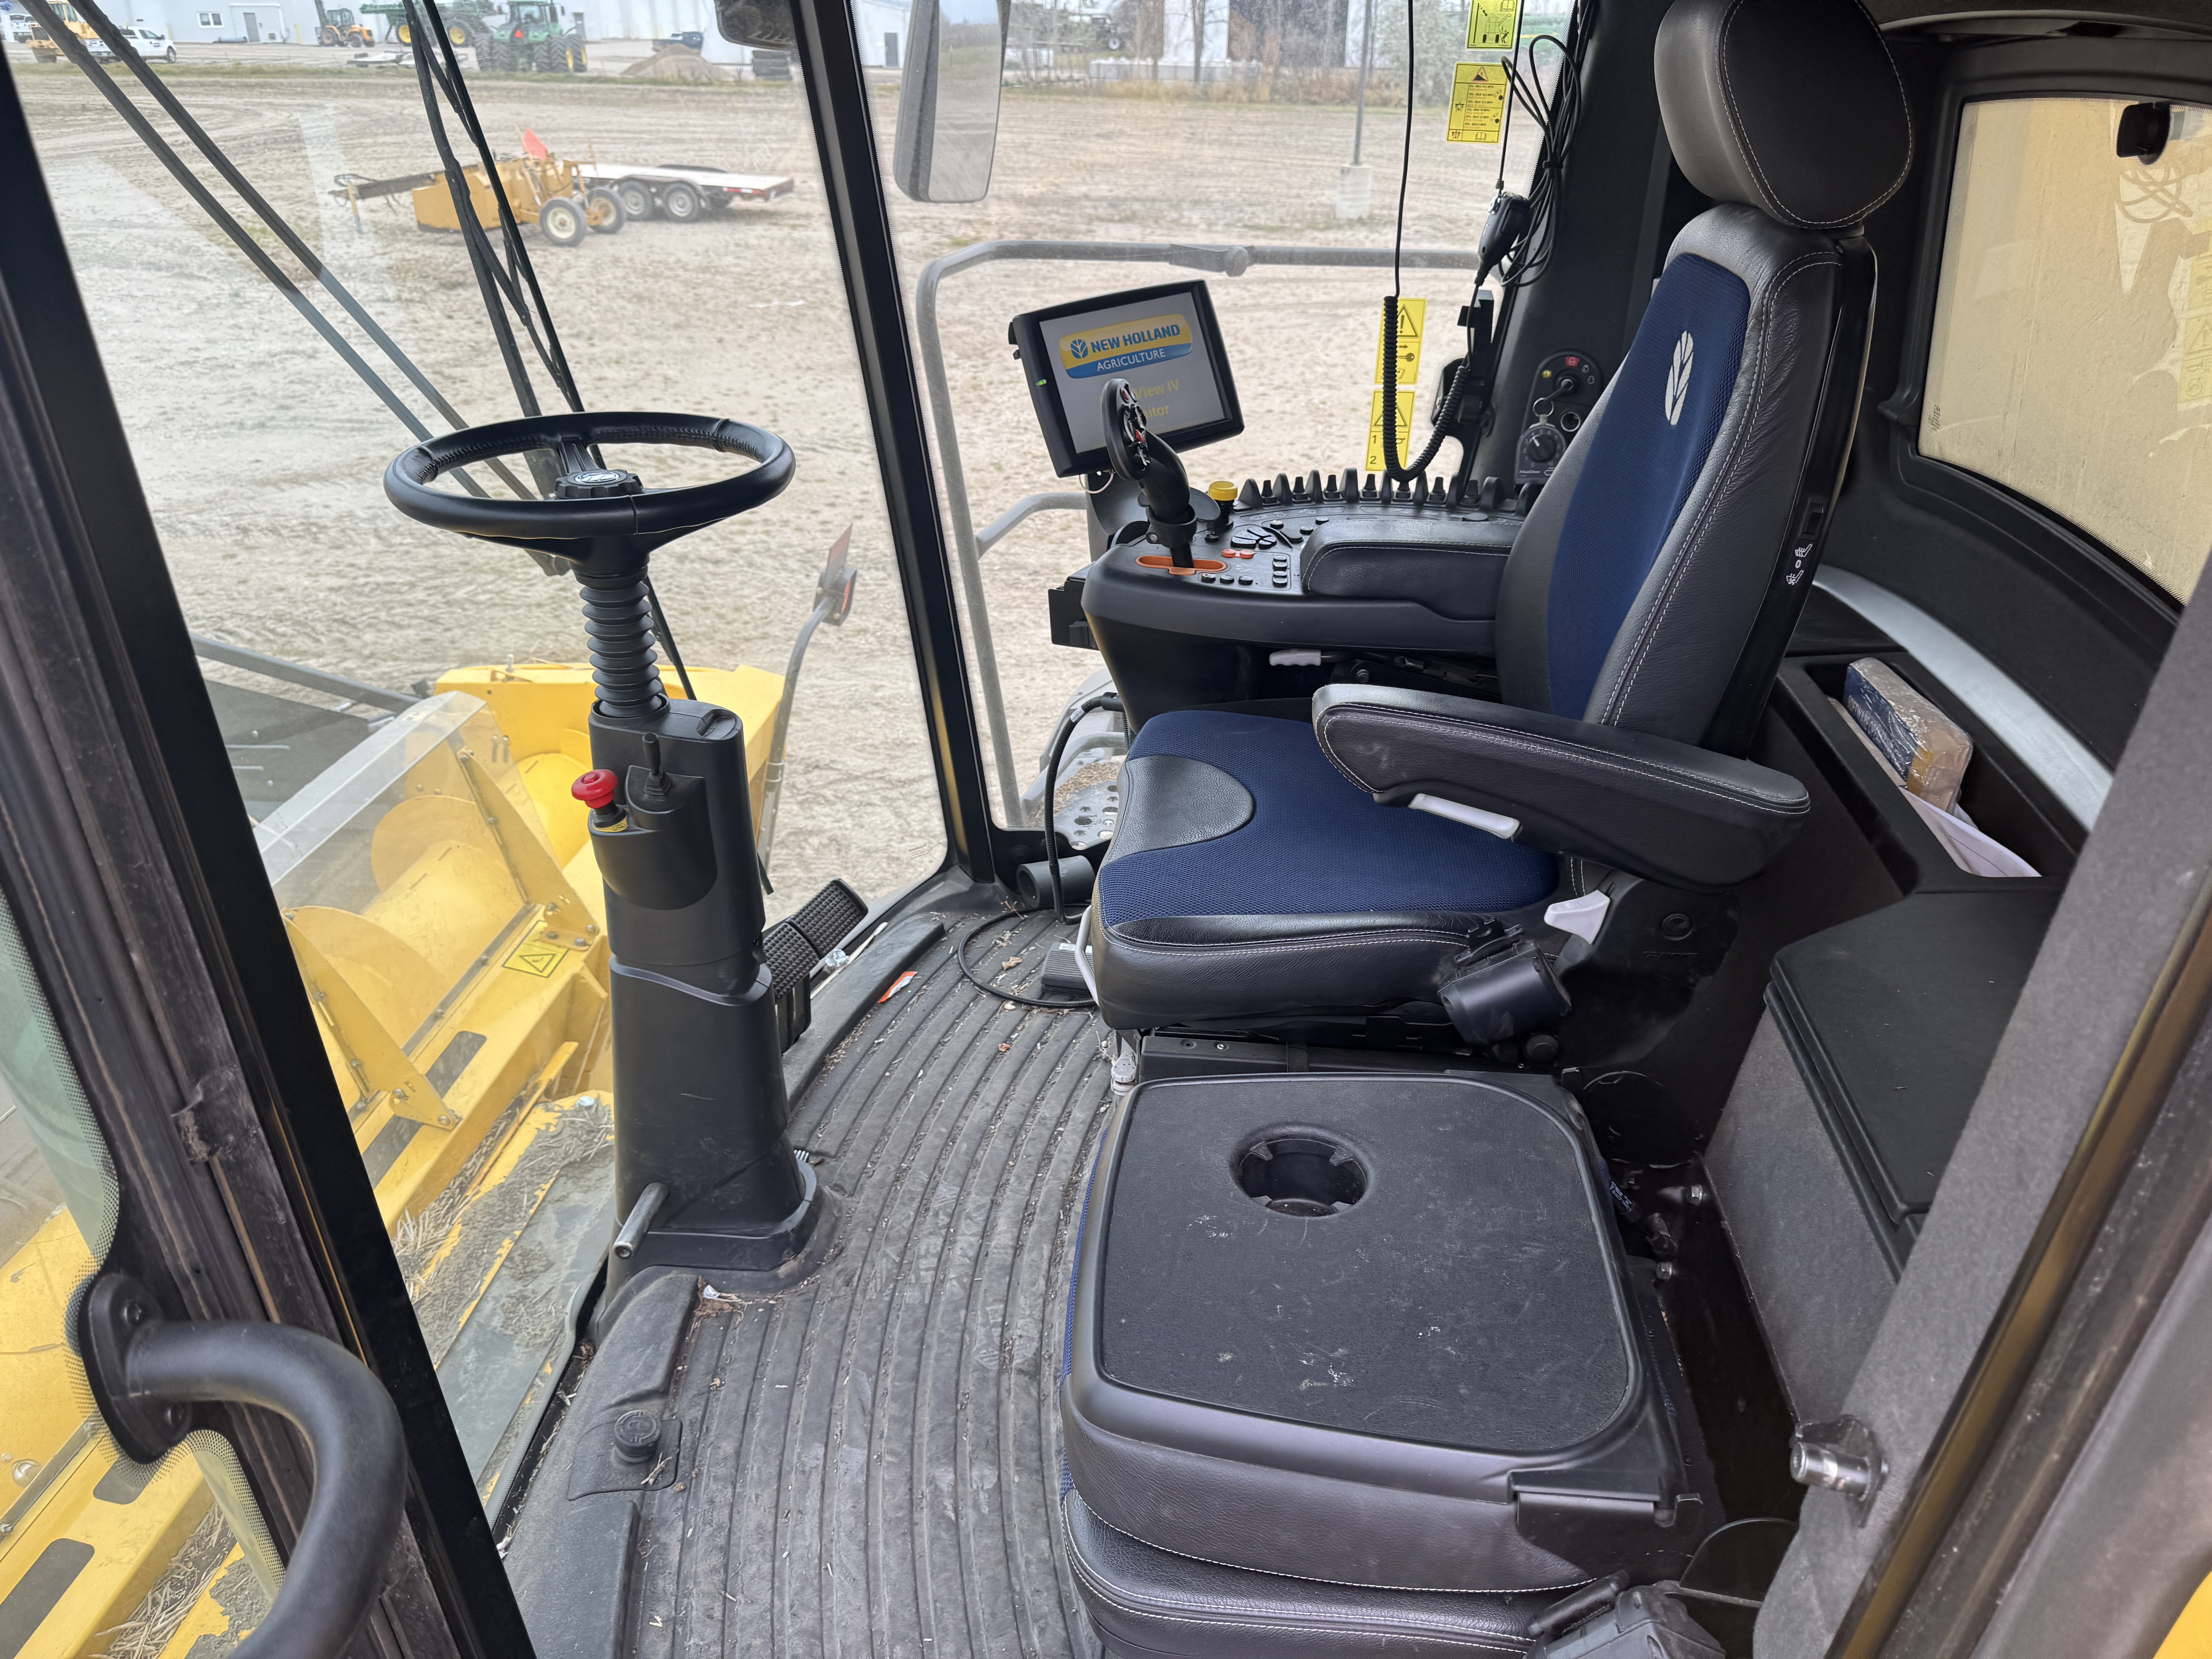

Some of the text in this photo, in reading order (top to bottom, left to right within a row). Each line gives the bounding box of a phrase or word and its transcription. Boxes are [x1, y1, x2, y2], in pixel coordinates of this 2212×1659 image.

[1091, 324, 1180, 353] NEW HOLLAND
[1097, 349, 1165, 371] AGRICULTURE
[1166, 378, 1180, 392] IV
[1143, 405, 1170, 419] nitor
[1372, 435, 1377, 444] 1
[1370, 456, 1377, 464] 2
